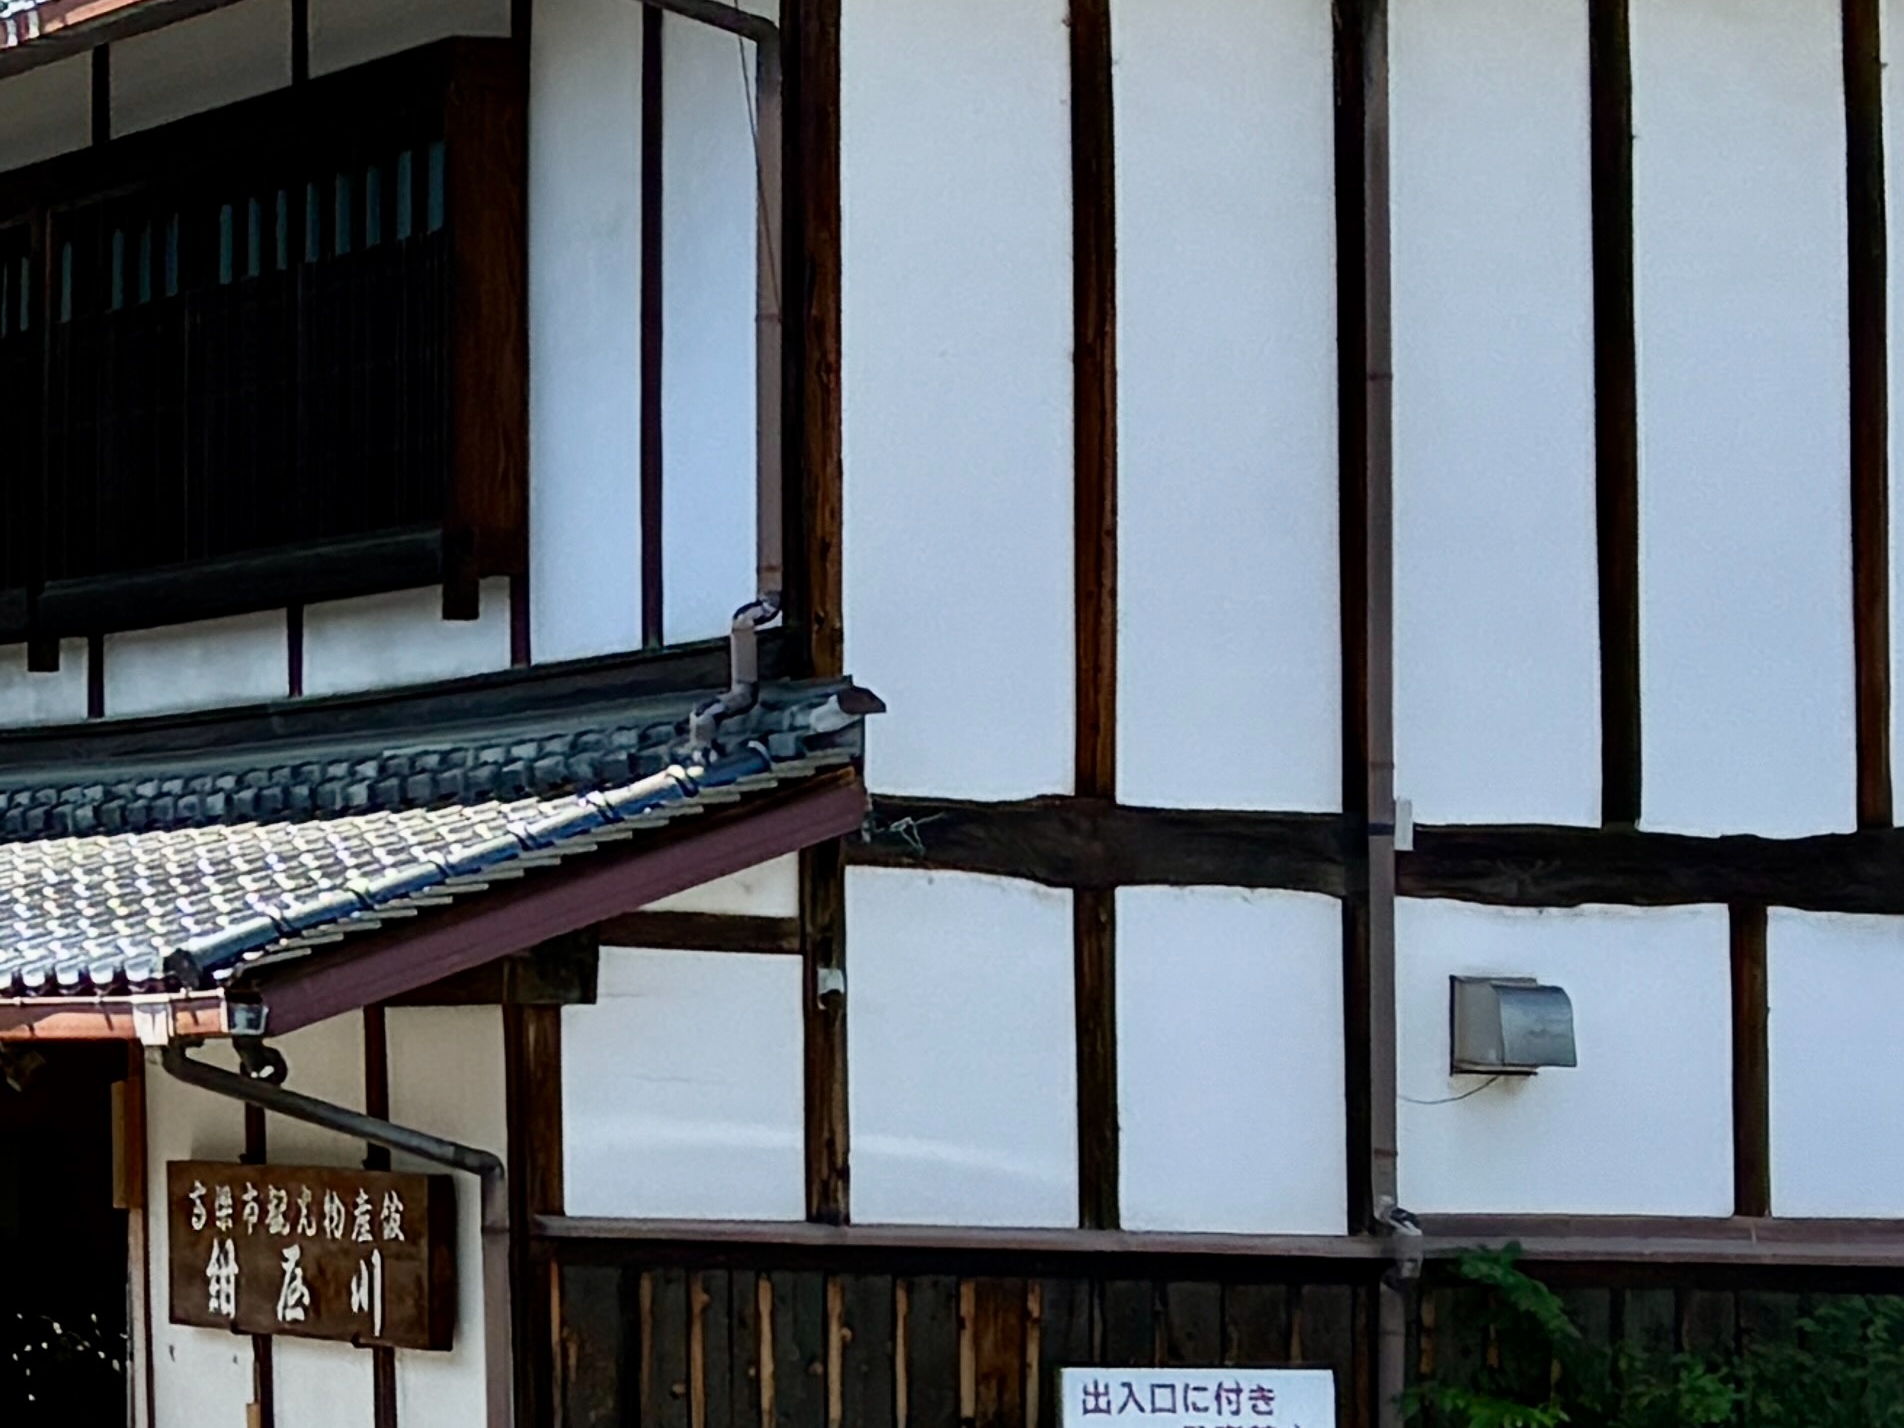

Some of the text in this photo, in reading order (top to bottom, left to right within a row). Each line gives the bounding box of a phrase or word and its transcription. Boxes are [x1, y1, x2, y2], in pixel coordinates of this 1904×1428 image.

[1082, 1379, 1275, 1417] 出入口に付き
